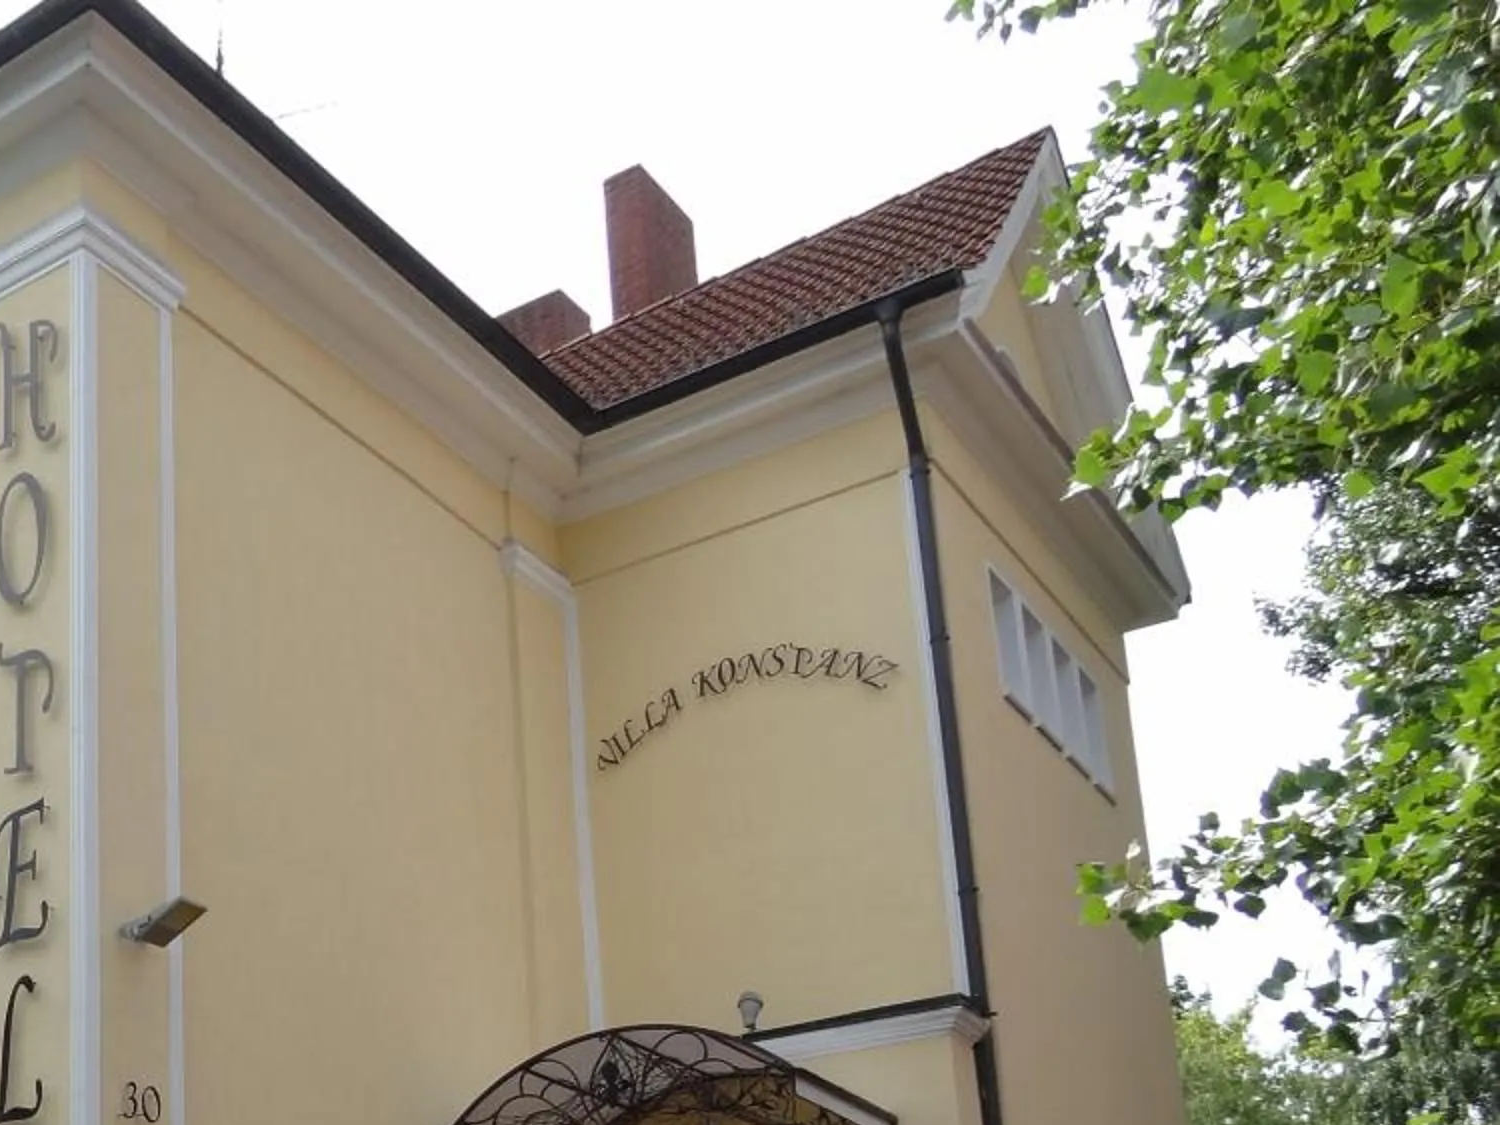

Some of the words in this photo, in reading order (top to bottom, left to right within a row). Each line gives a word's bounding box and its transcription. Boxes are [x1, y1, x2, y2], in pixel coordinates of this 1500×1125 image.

[596, 687, 683, 771] VILLA
[691, 642, 900, 697] KONSTANZ
[116, 1081, 162, 1123] 30
